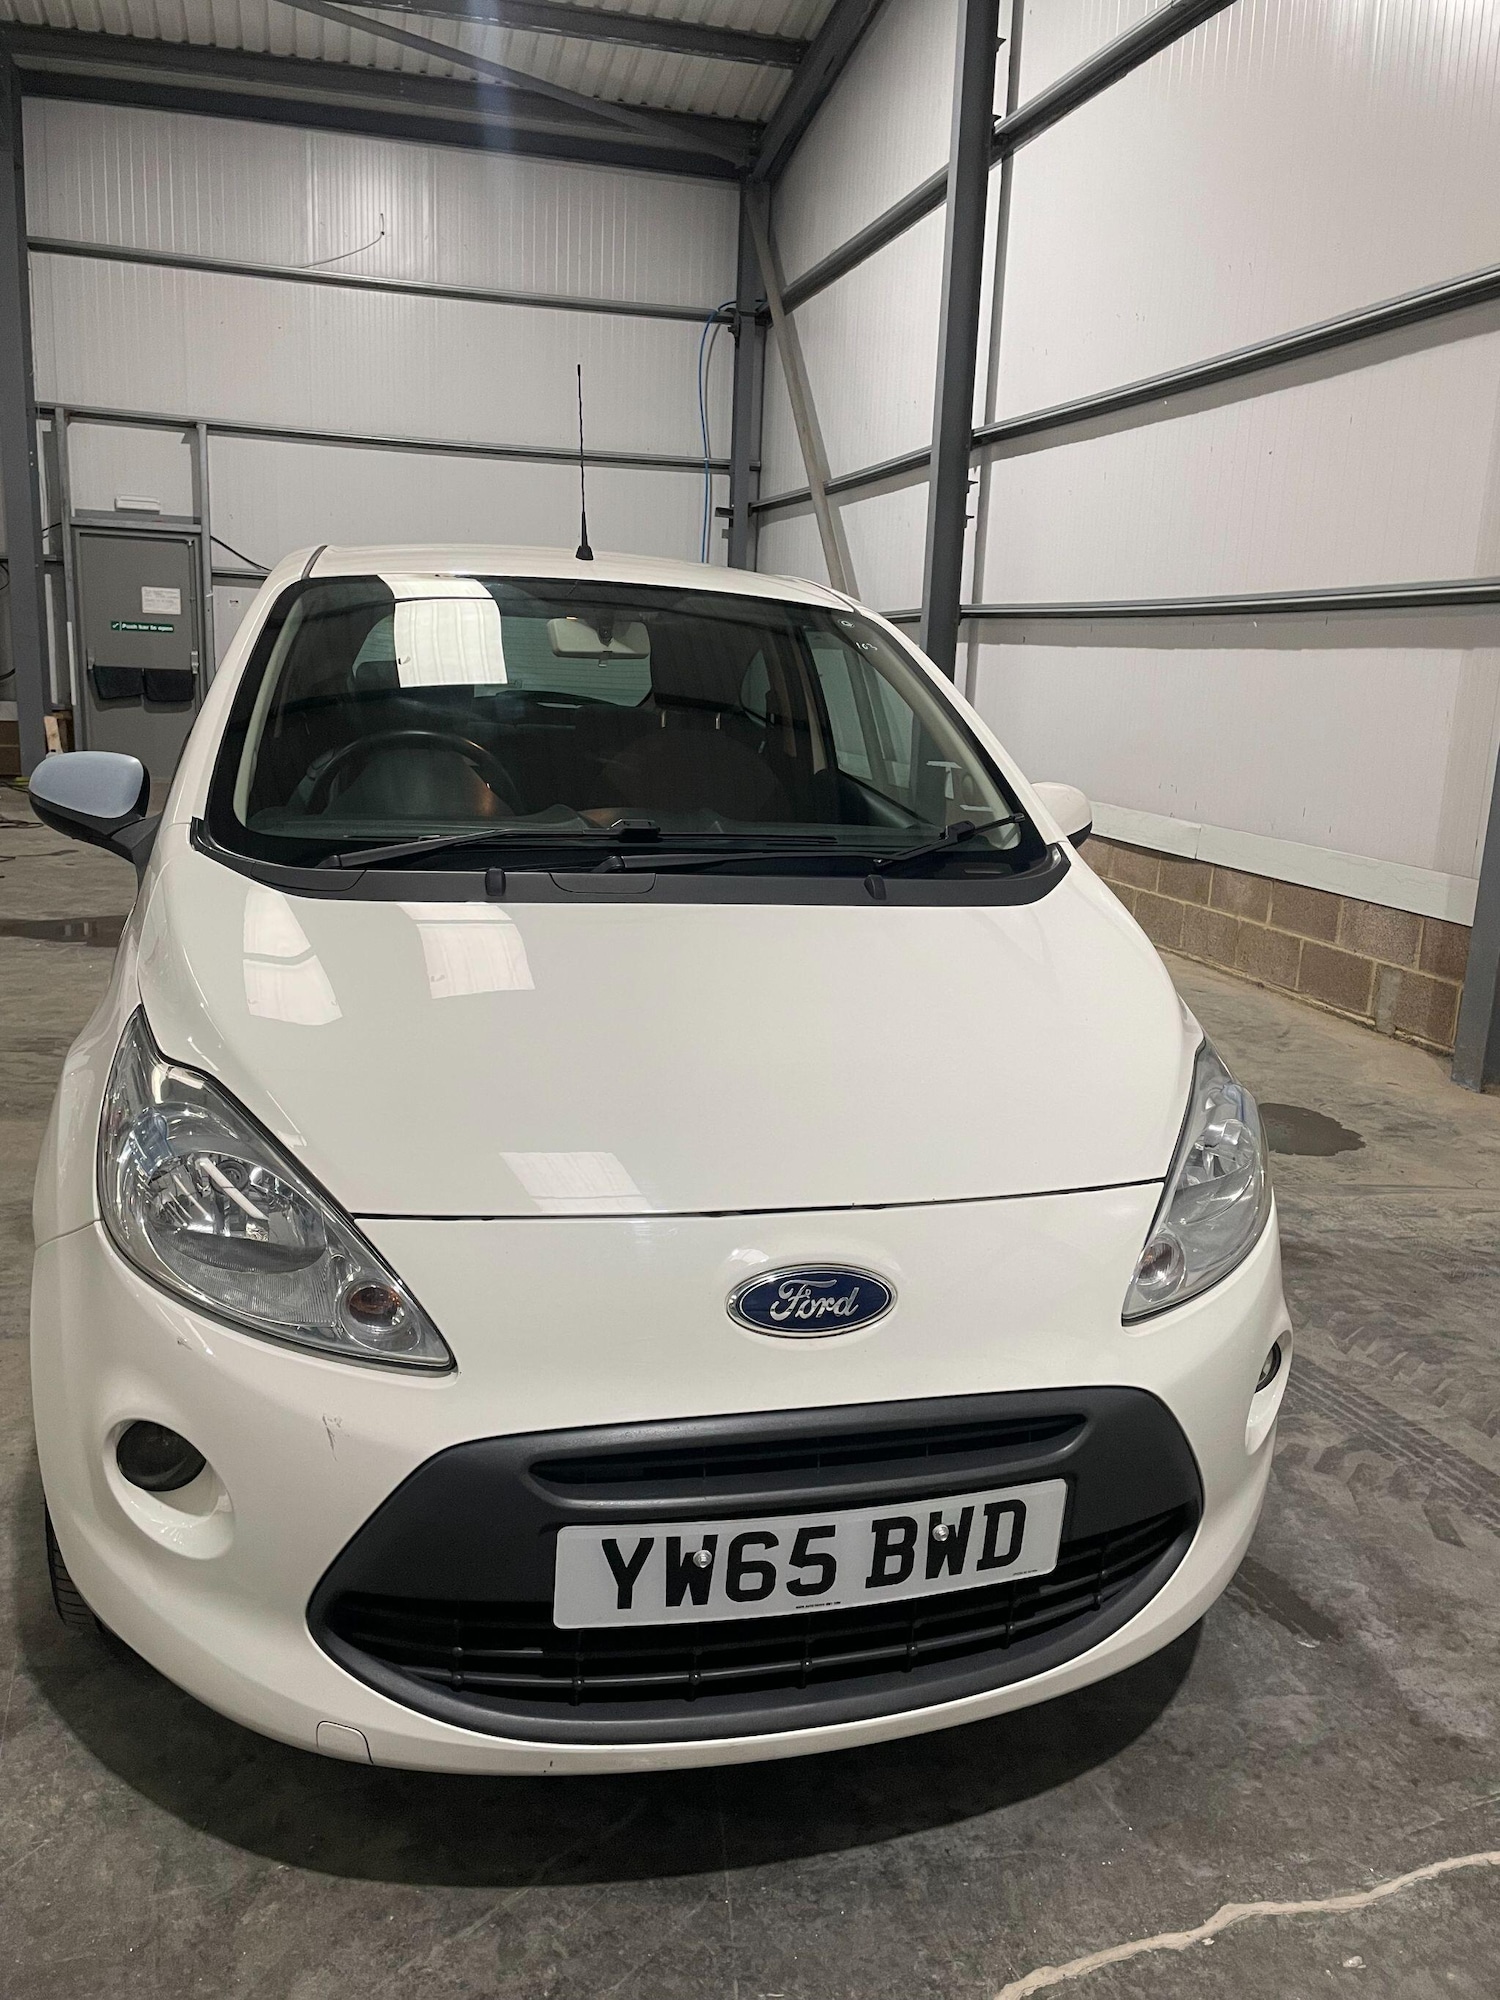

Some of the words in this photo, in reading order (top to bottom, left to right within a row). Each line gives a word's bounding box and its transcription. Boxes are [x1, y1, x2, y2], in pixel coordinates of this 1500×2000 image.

[769, 1279, 859, 1321] Ford
[601, 1524, 836, 1610] YW65
[865, 1498, 1028, 1589] BWD
